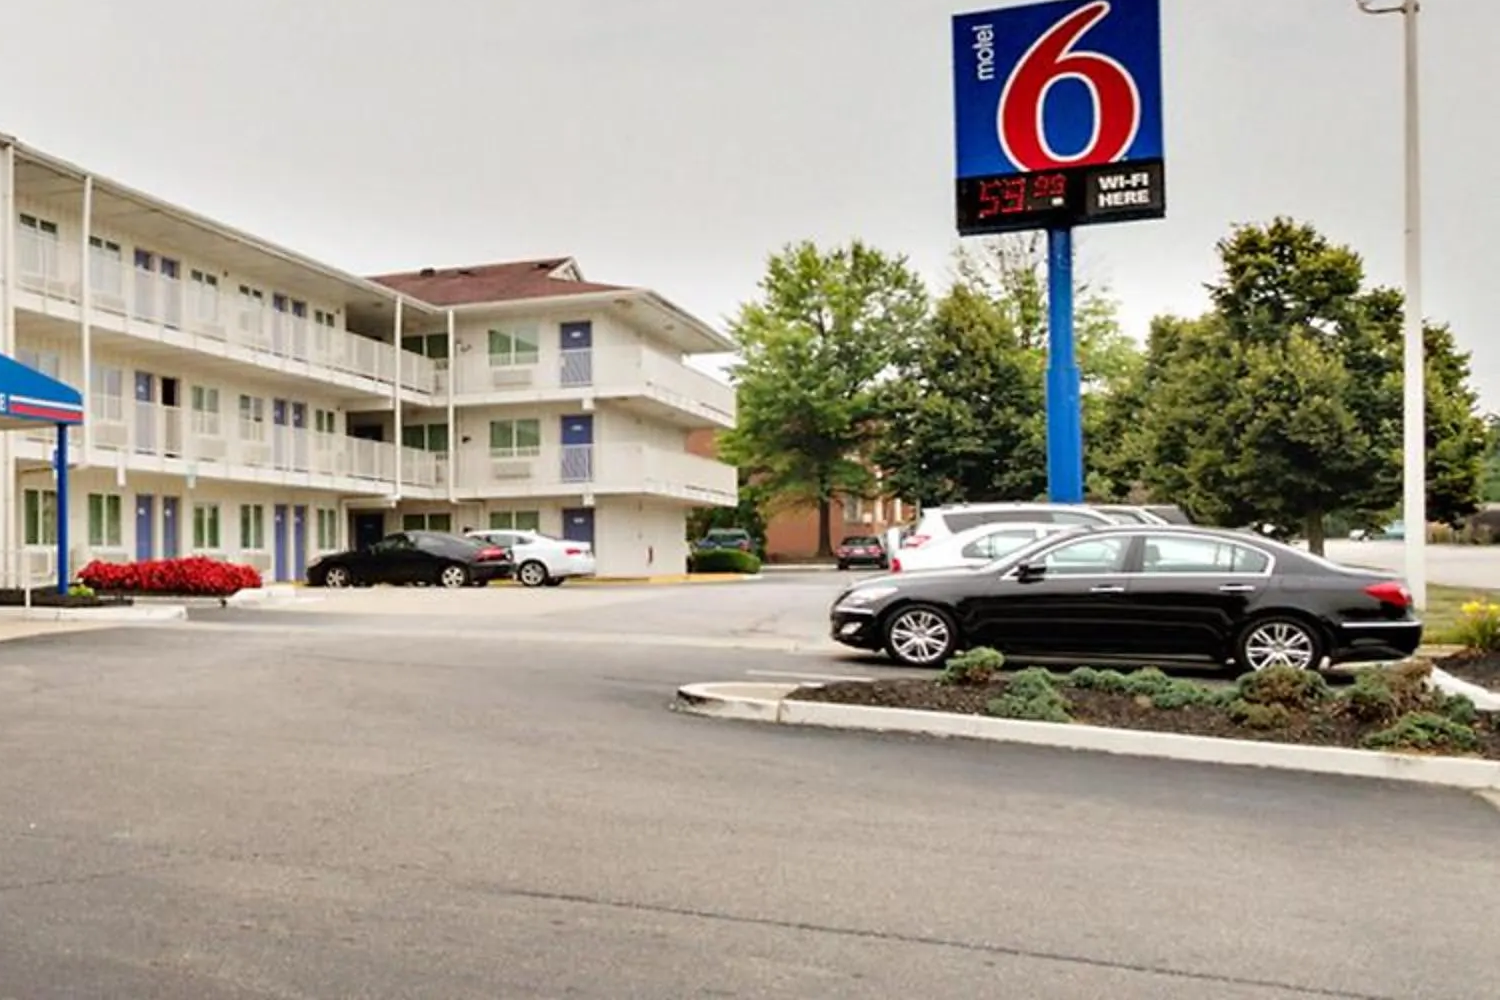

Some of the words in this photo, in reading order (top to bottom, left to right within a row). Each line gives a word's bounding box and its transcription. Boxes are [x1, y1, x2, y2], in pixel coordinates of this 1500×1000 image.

[972, 24, 994, 80] motel
[997, 0, 1141, 172] 6
[1098, 173, 1149, 190] WI-FI
[1098, 189, 1149, 207] HERE
